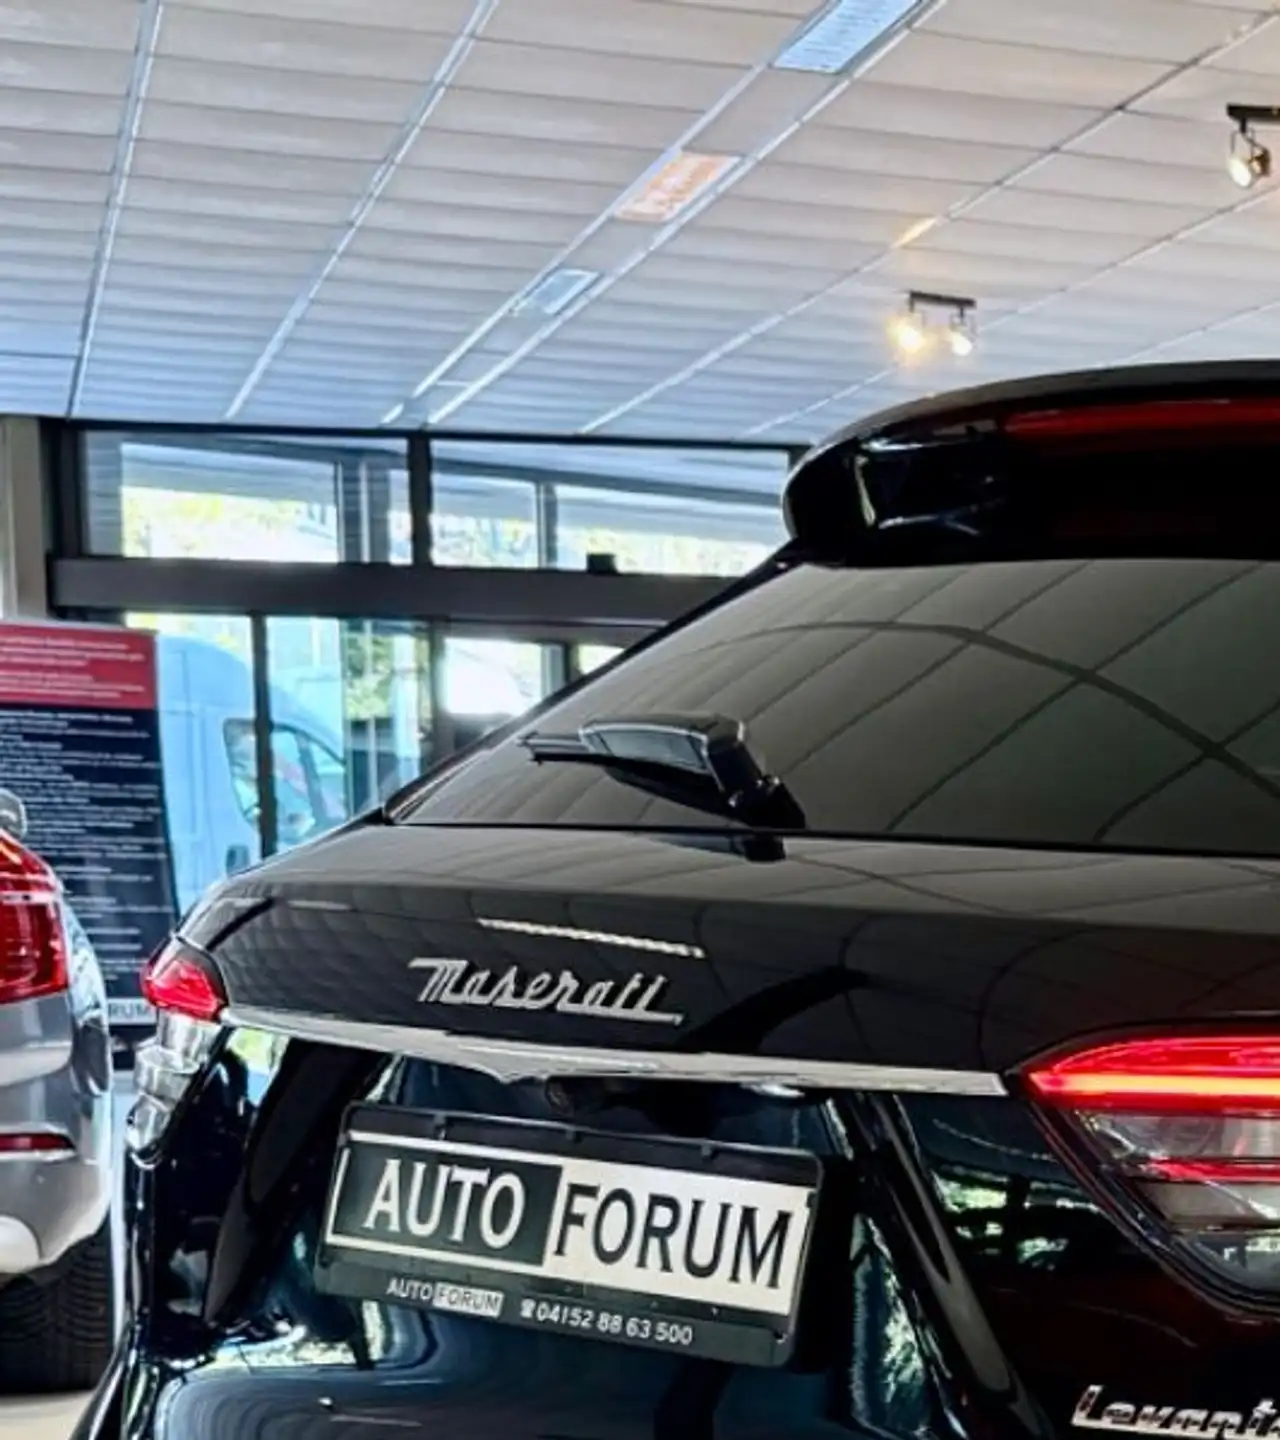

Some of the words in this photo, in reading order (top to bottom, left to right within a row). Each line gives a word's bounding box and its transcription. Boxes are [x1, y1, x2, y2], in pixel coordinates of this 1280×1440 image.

[408, 958, 685, 1026] Maserati
[362, 1158, 527, 1250] AUTO
[552, 1181, 794, 1290] FORUM
[537, 1303, 592, 1328] 04152
[597, 1312, 622, 1334] 88
[626, 1317, 651, 1338] 63
[655, 1323, 693, 1346] 500
